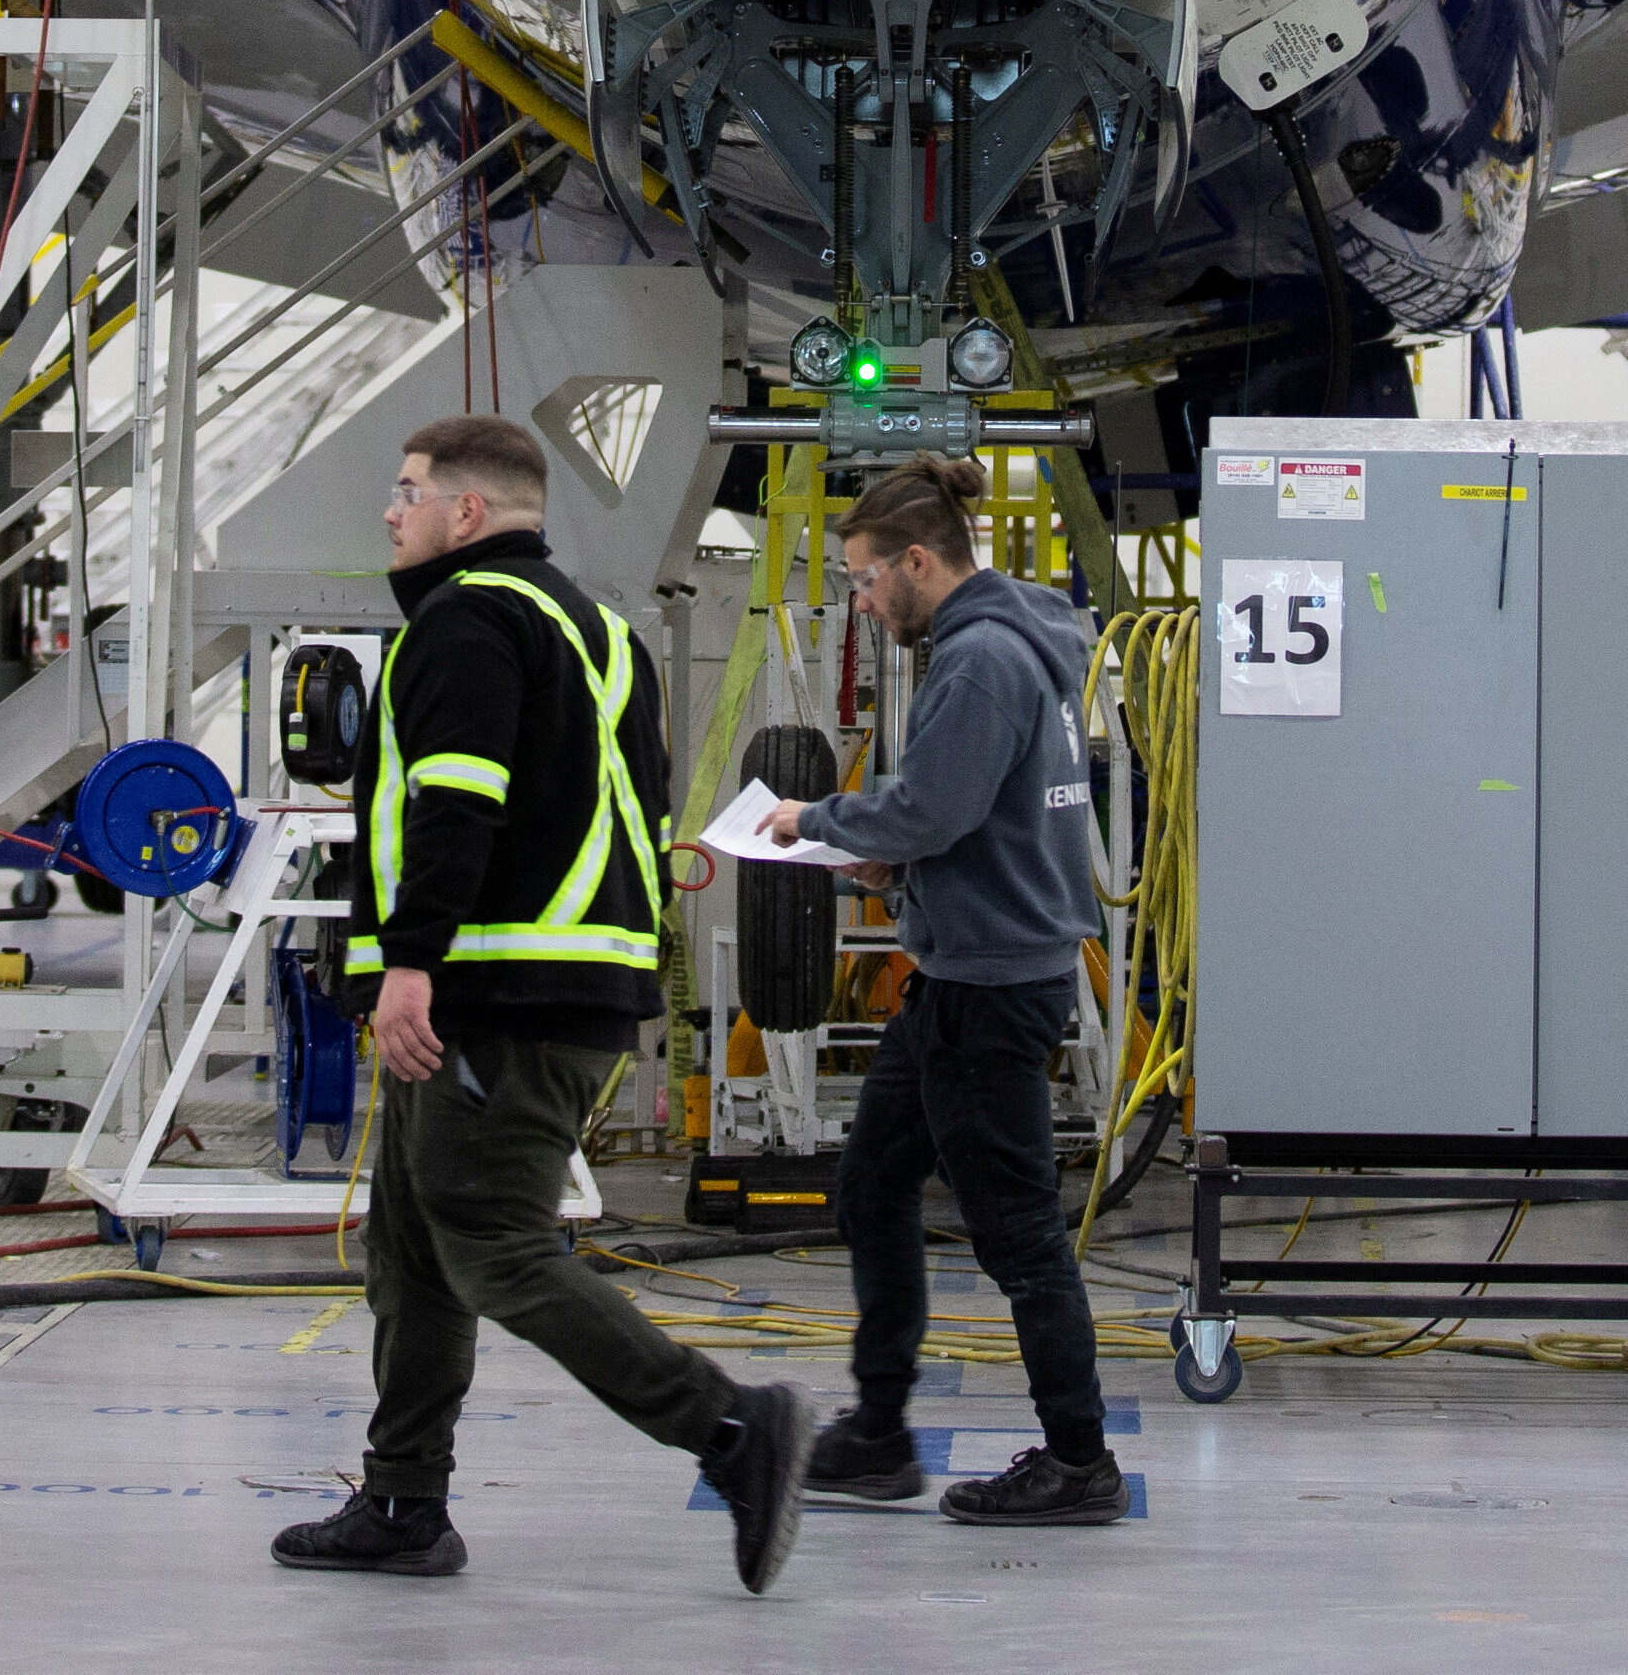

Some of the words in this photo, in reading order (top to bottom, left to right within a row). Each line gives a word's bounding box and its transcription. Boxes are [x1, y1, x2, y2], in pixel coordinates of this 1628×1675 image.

[1305, 465, 1348, 475] DANGER
[1485, 488, 1509, 498] ARRIER
[1232, 595, 1330, 665] 15
